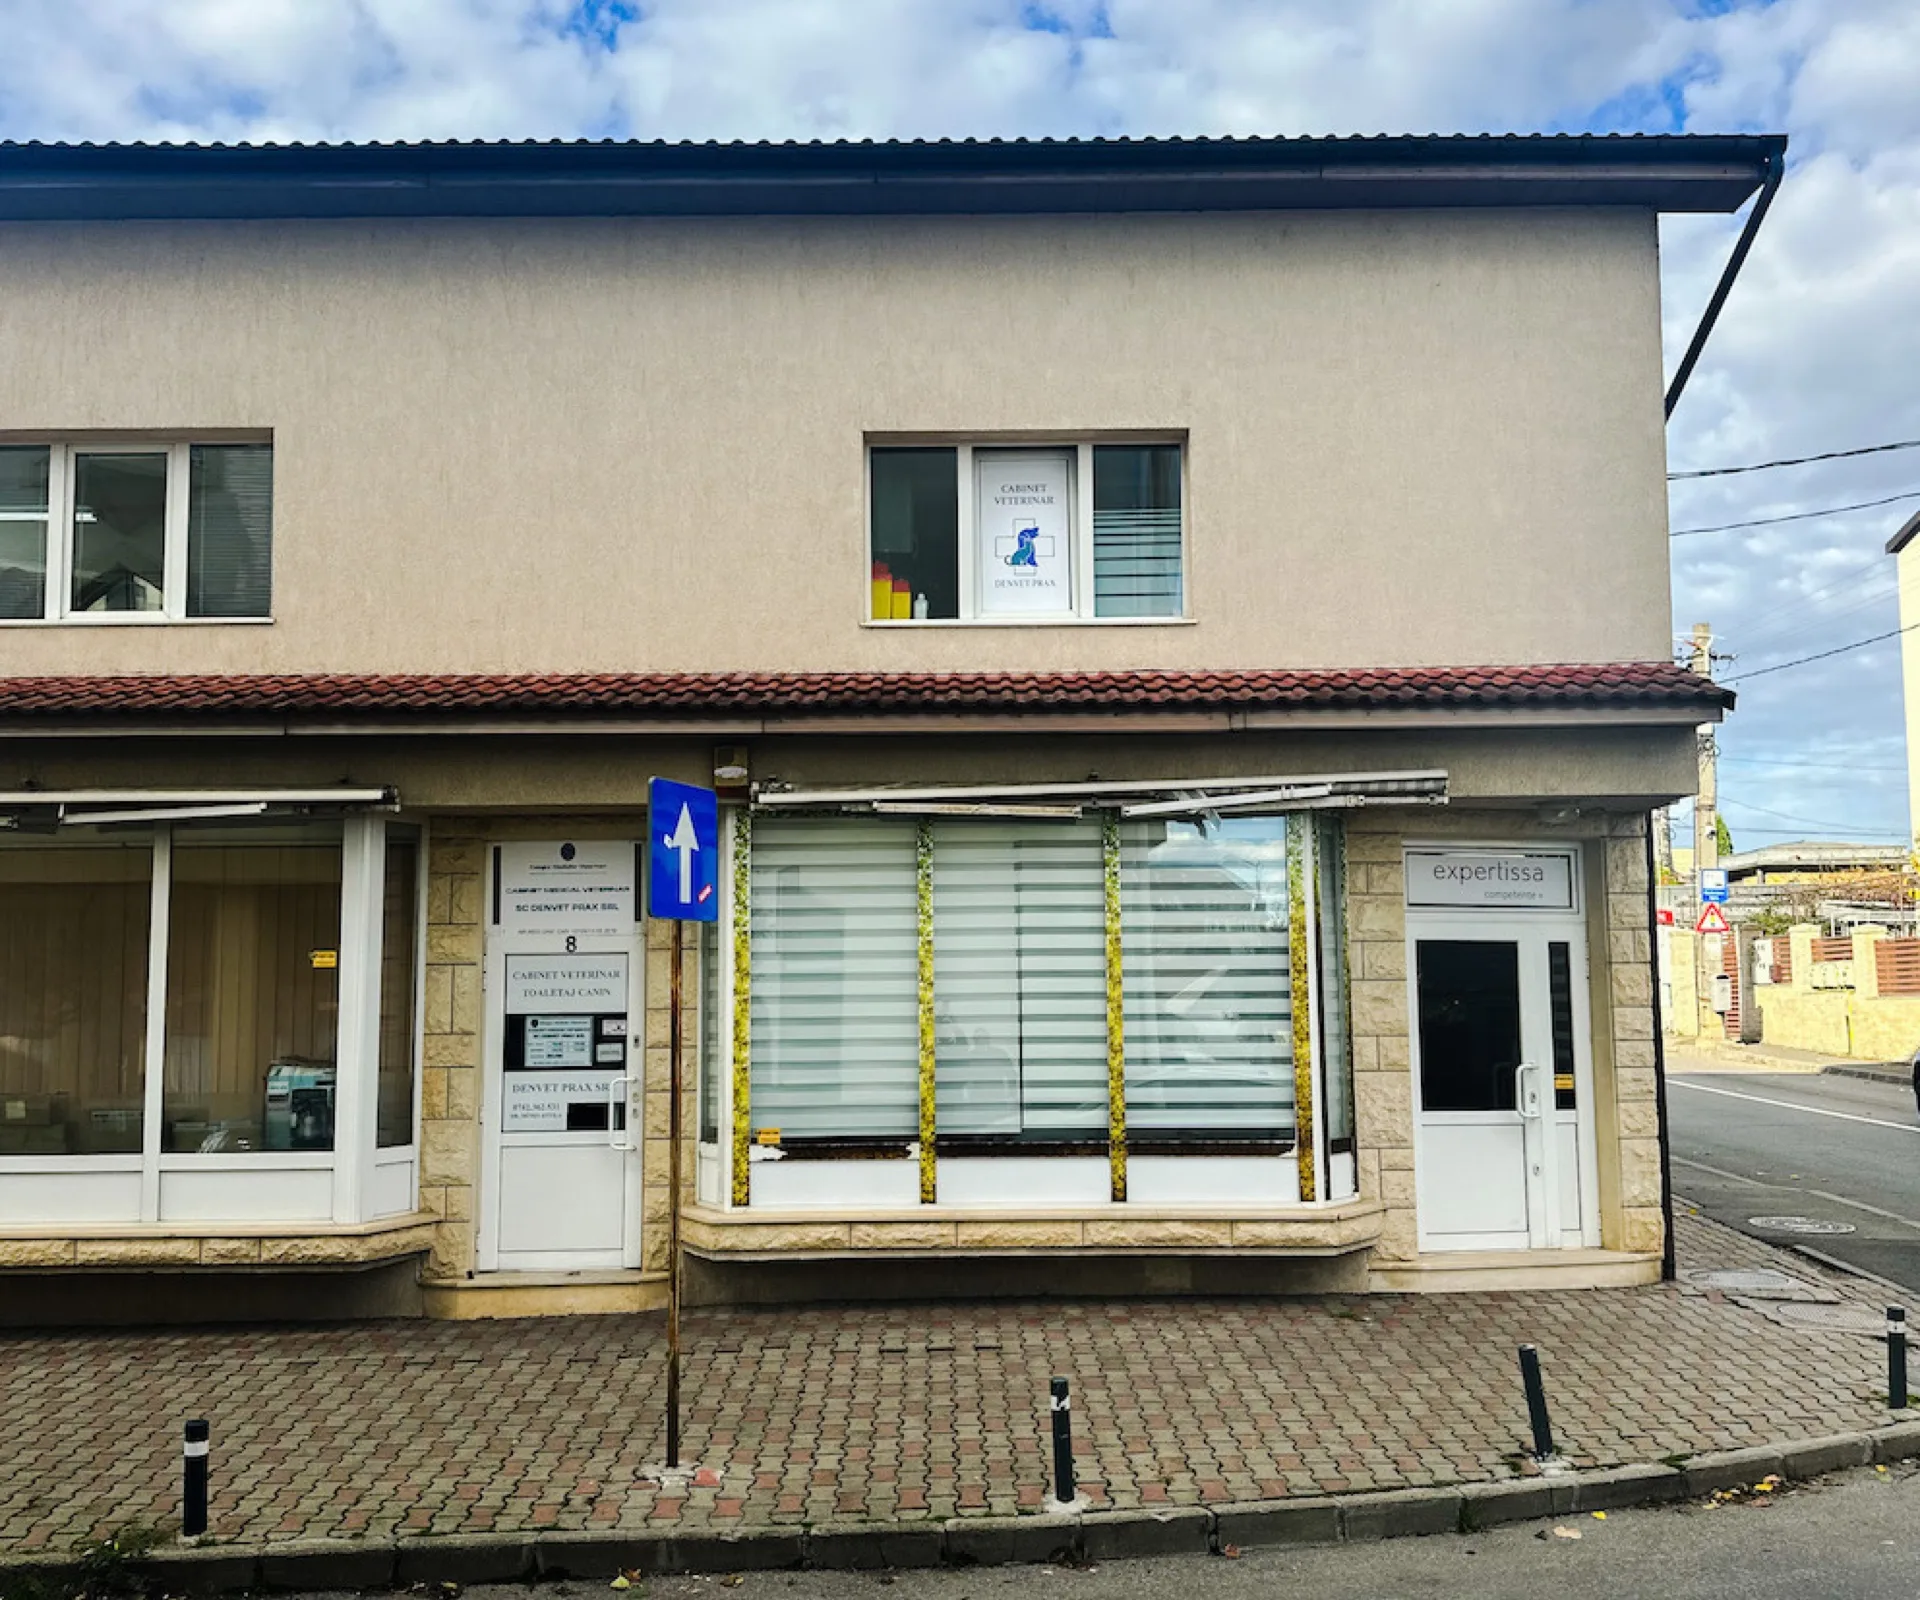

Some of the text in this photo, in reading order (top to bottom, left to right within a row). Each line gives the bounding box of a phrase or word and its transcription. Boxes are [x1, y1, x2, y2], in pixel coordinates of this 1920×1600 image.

[1000, 483, 1047, 494] CABINET
[994, 496, 1054, 505] VETERINAR
[1433, 861, 1544, 885] expertissa
[565, 936, 577, 953] 8
[512, 970, 621, 980] CABINET VETERINAR
[523, 988, 611, 998] TOALETAJ CANIN
[512, 1083, 612, 1094] DENVET PRAX SR
